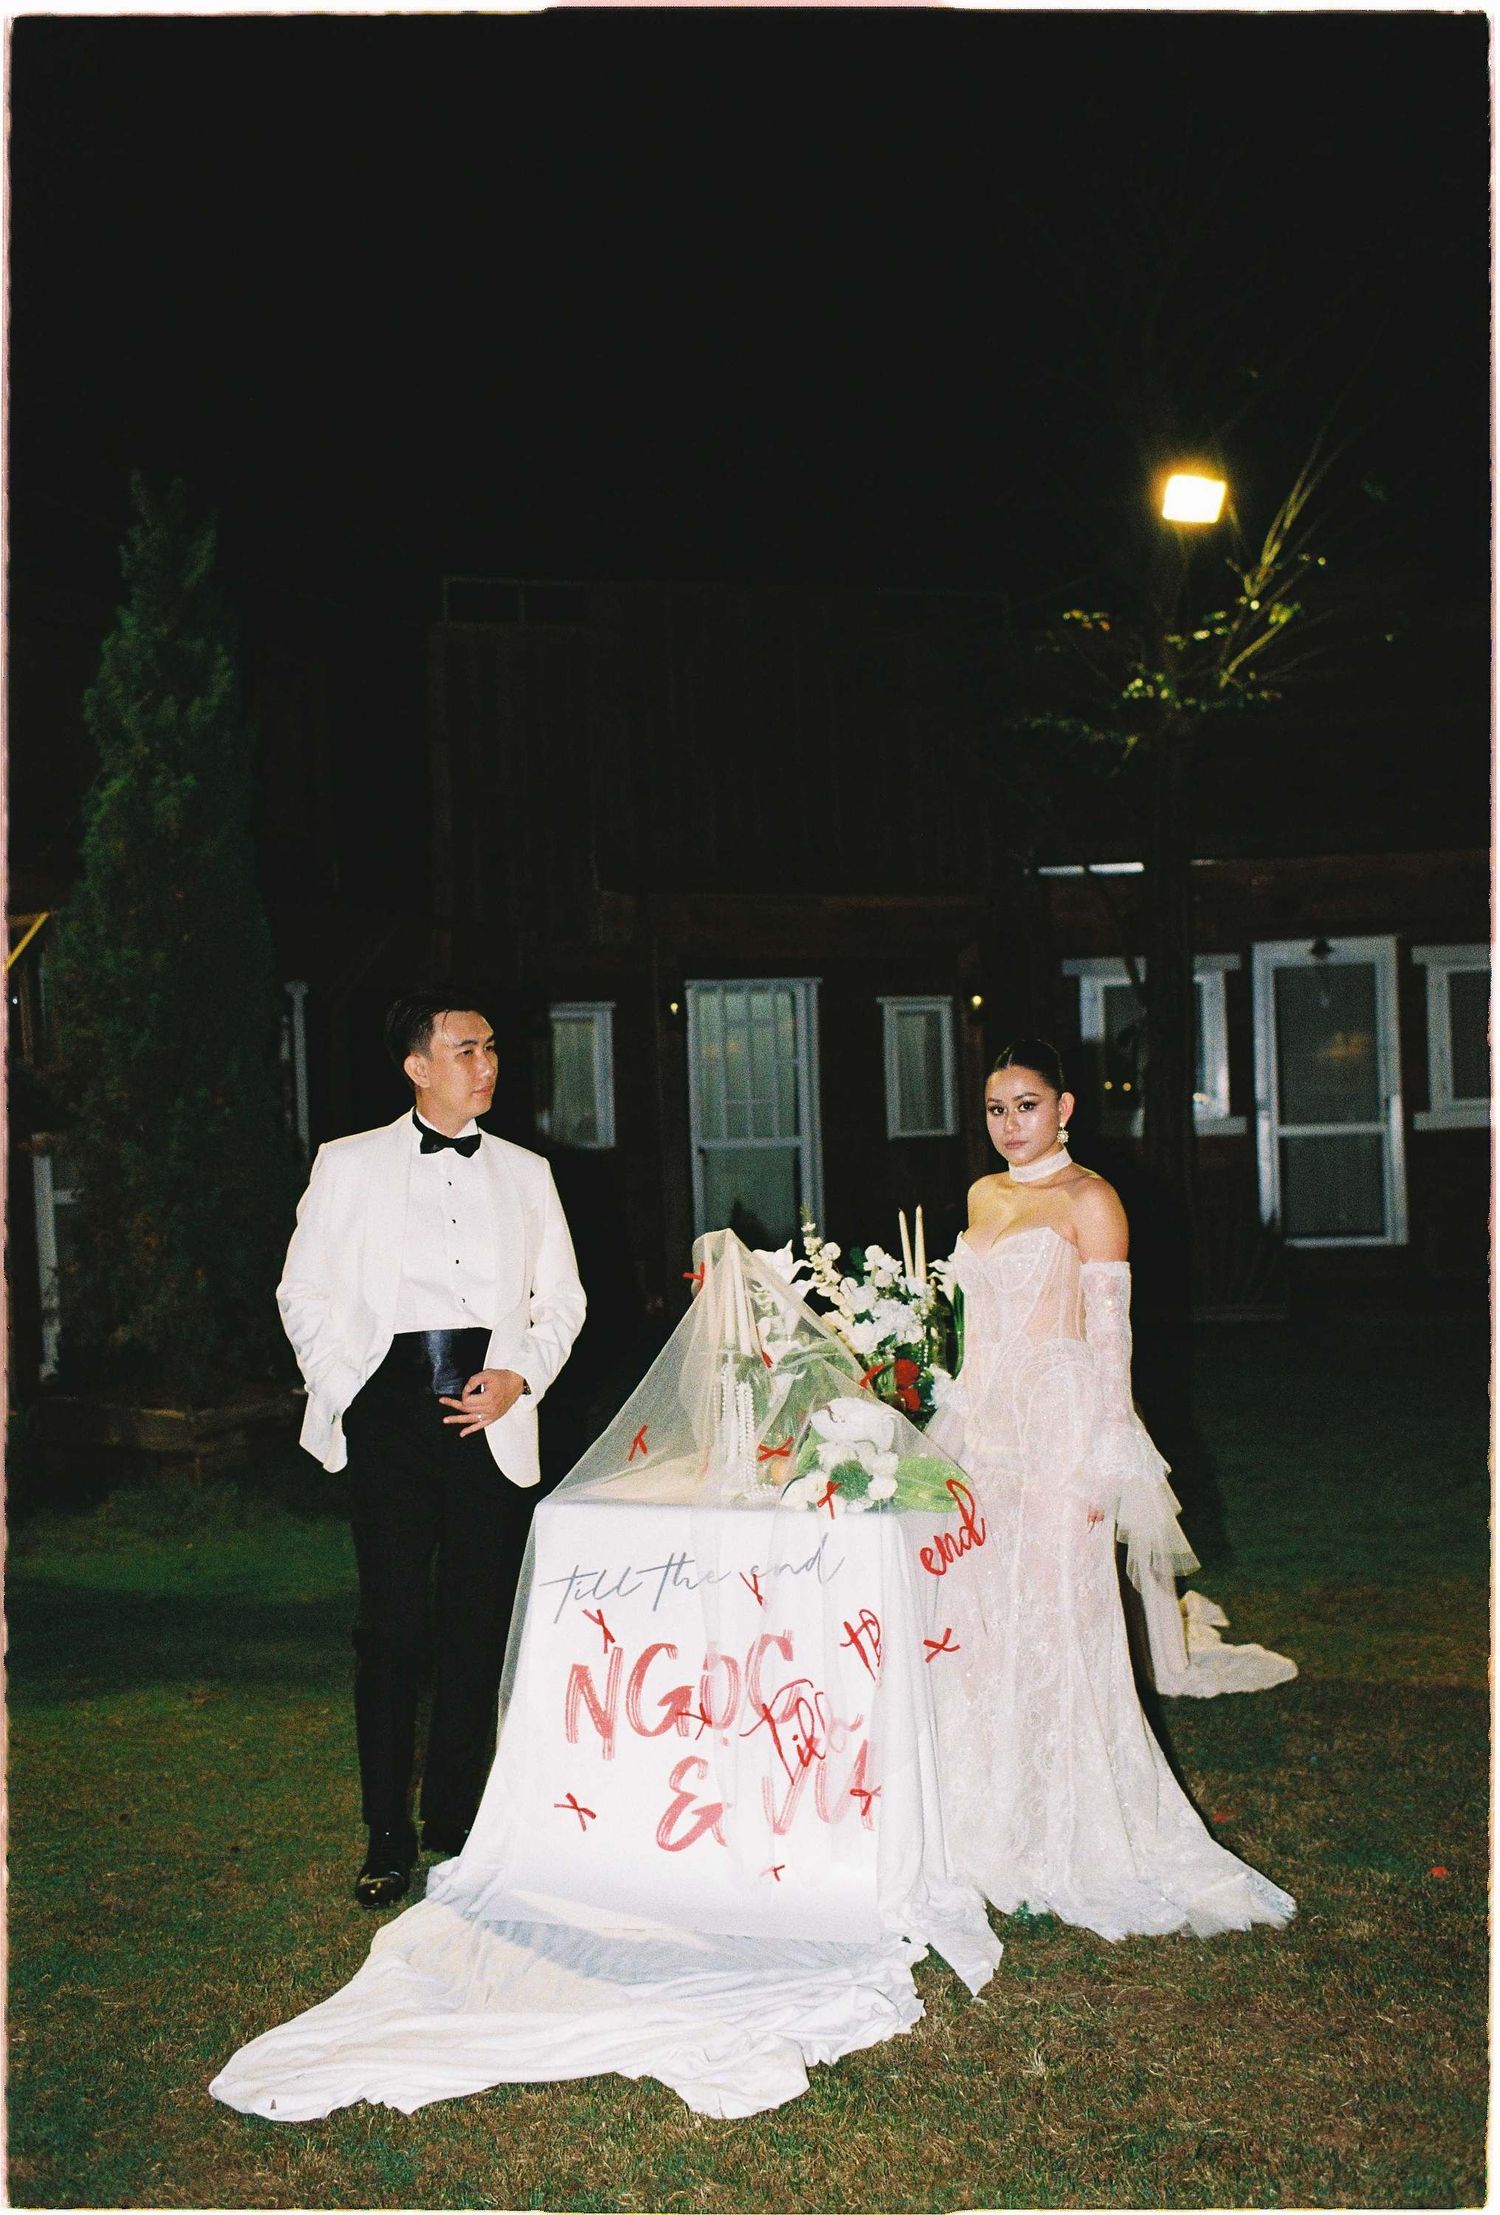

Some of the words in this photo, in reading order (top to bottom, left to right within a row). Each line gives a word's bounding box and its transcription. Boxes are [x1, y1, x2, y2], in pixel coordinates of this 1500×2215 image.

[919, 1478, 986, 1576] end
[635, 1551, 732, 1612] the
[655, 1754, 729, 1852] &
